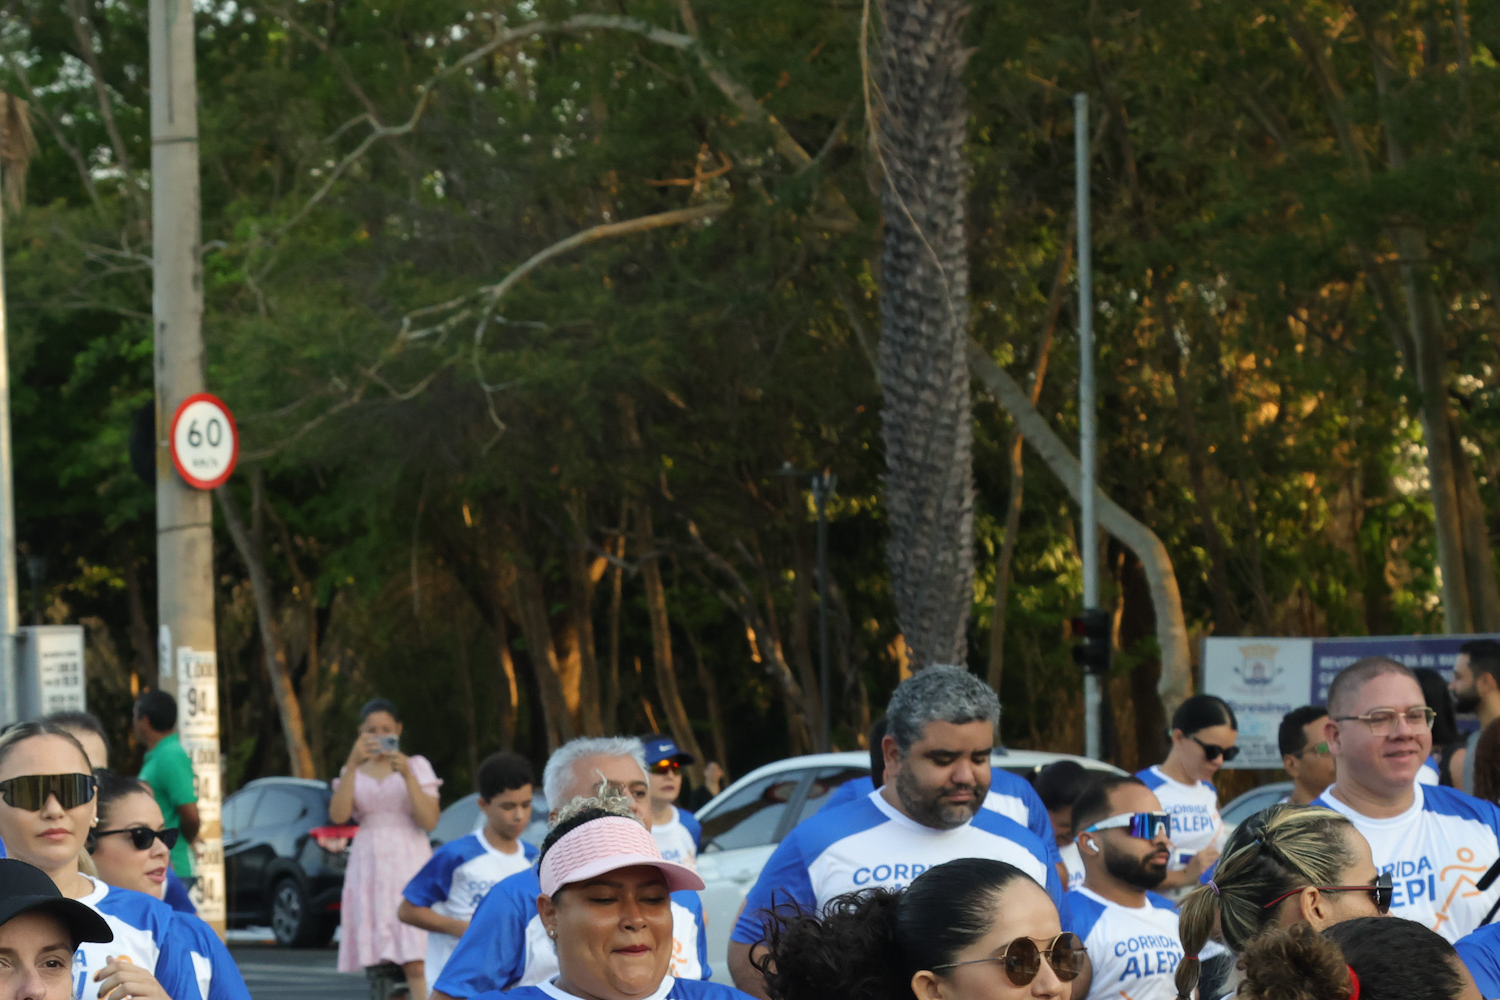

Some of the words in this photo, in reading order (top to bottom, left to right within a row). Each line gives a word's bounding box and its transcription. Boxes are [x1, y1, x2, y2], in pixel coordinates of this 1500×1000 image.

[188, 418, 222, 447] 60
[852, 863, 933, 886] CORR
[1377, 856, 1432, 879] RIDA
[1390, 874, 1436, 908] EPI
